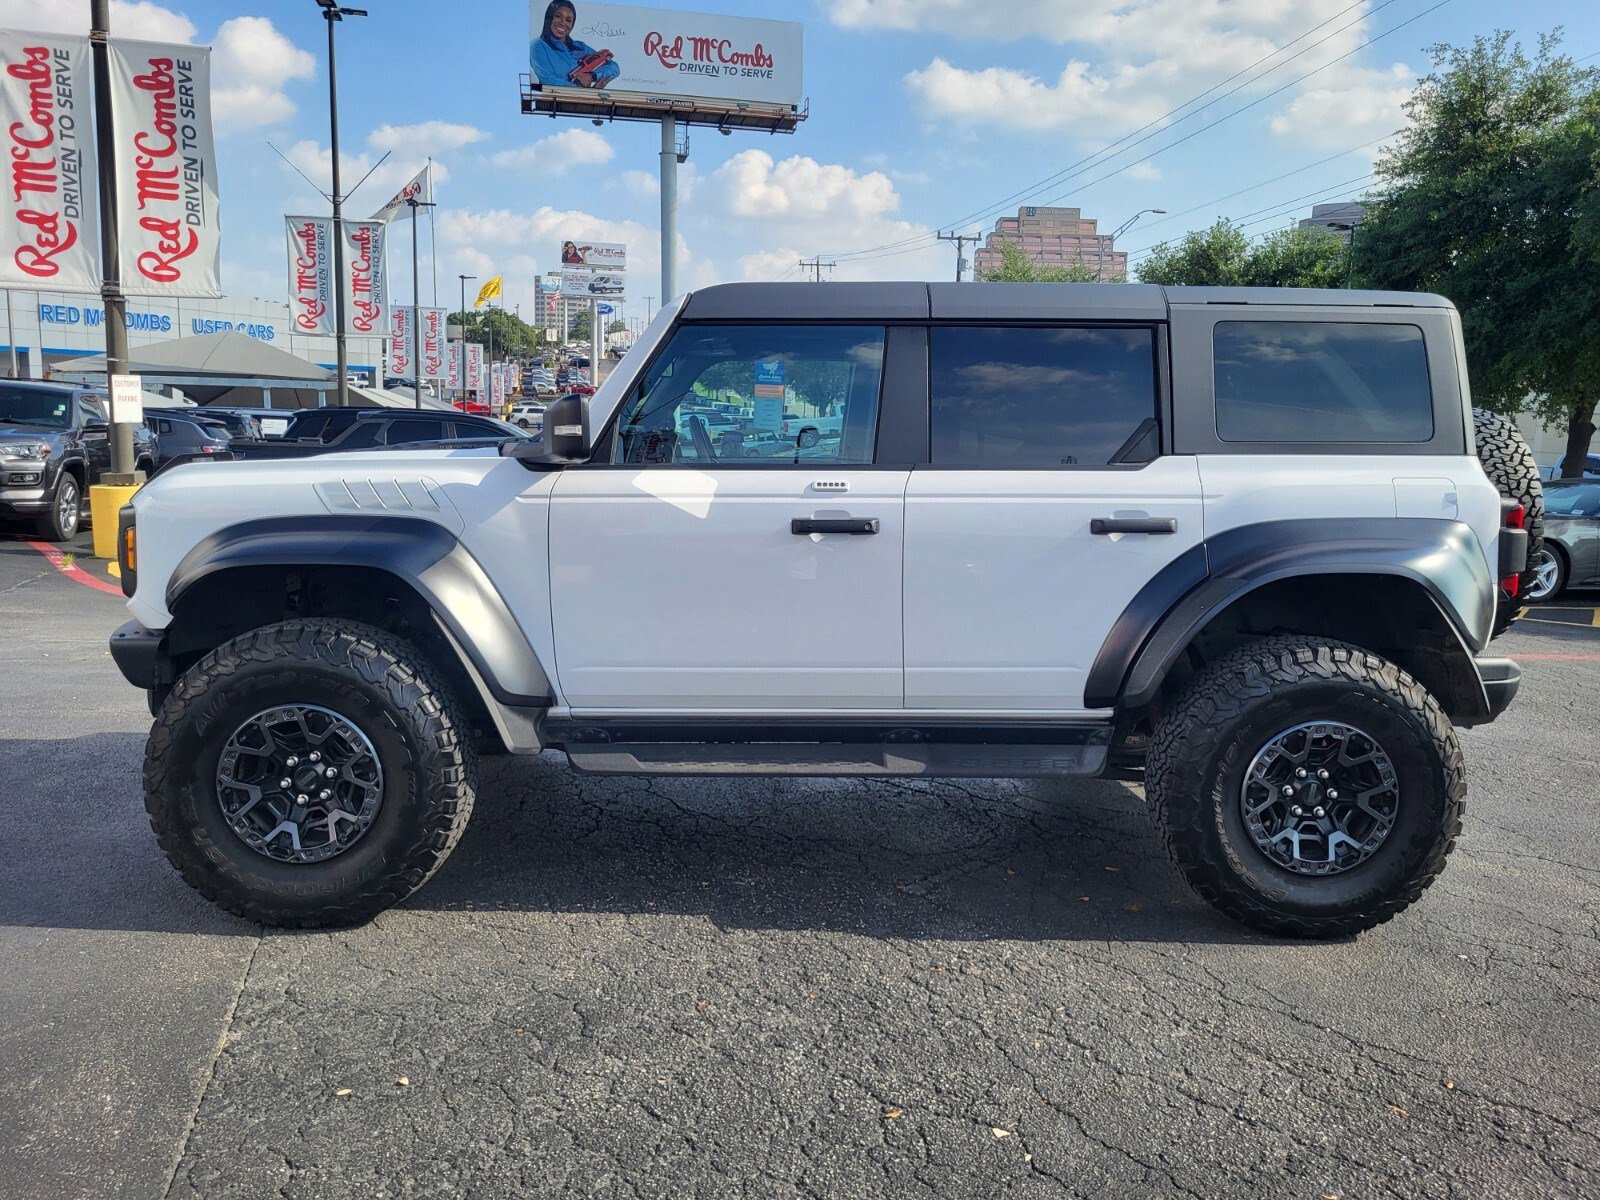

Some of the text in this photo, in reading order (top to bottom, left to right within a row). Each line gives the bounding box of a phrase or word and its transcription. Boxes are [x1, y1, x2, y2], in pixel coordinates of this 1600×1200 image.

[643, 31, 774, 69] Red McCombs
[679, 62, 774, 80] DRIVEN TO SERVE
[6, 46, 78, 278] Red McCombs
[53, 48, 80, 220] DRIVEN TO SERVE
[132, 57, 199, 283] Red McCombs
[176, 58, 202, 227] DRIVEN TO SERVE
[296, 222, 327, 330] Red McCombs
[316, 223, 327, 302] DRIVEN TO SERVE
[351, 226, 381, 332] Red McCombs
[371, 227, 381, 304] DRIVEN TO SERVE
[41, 303, 81, 325] RED
[392, 309, 410, 375] Red McCombs
[425, 311, 442, 375] Red McCombs
